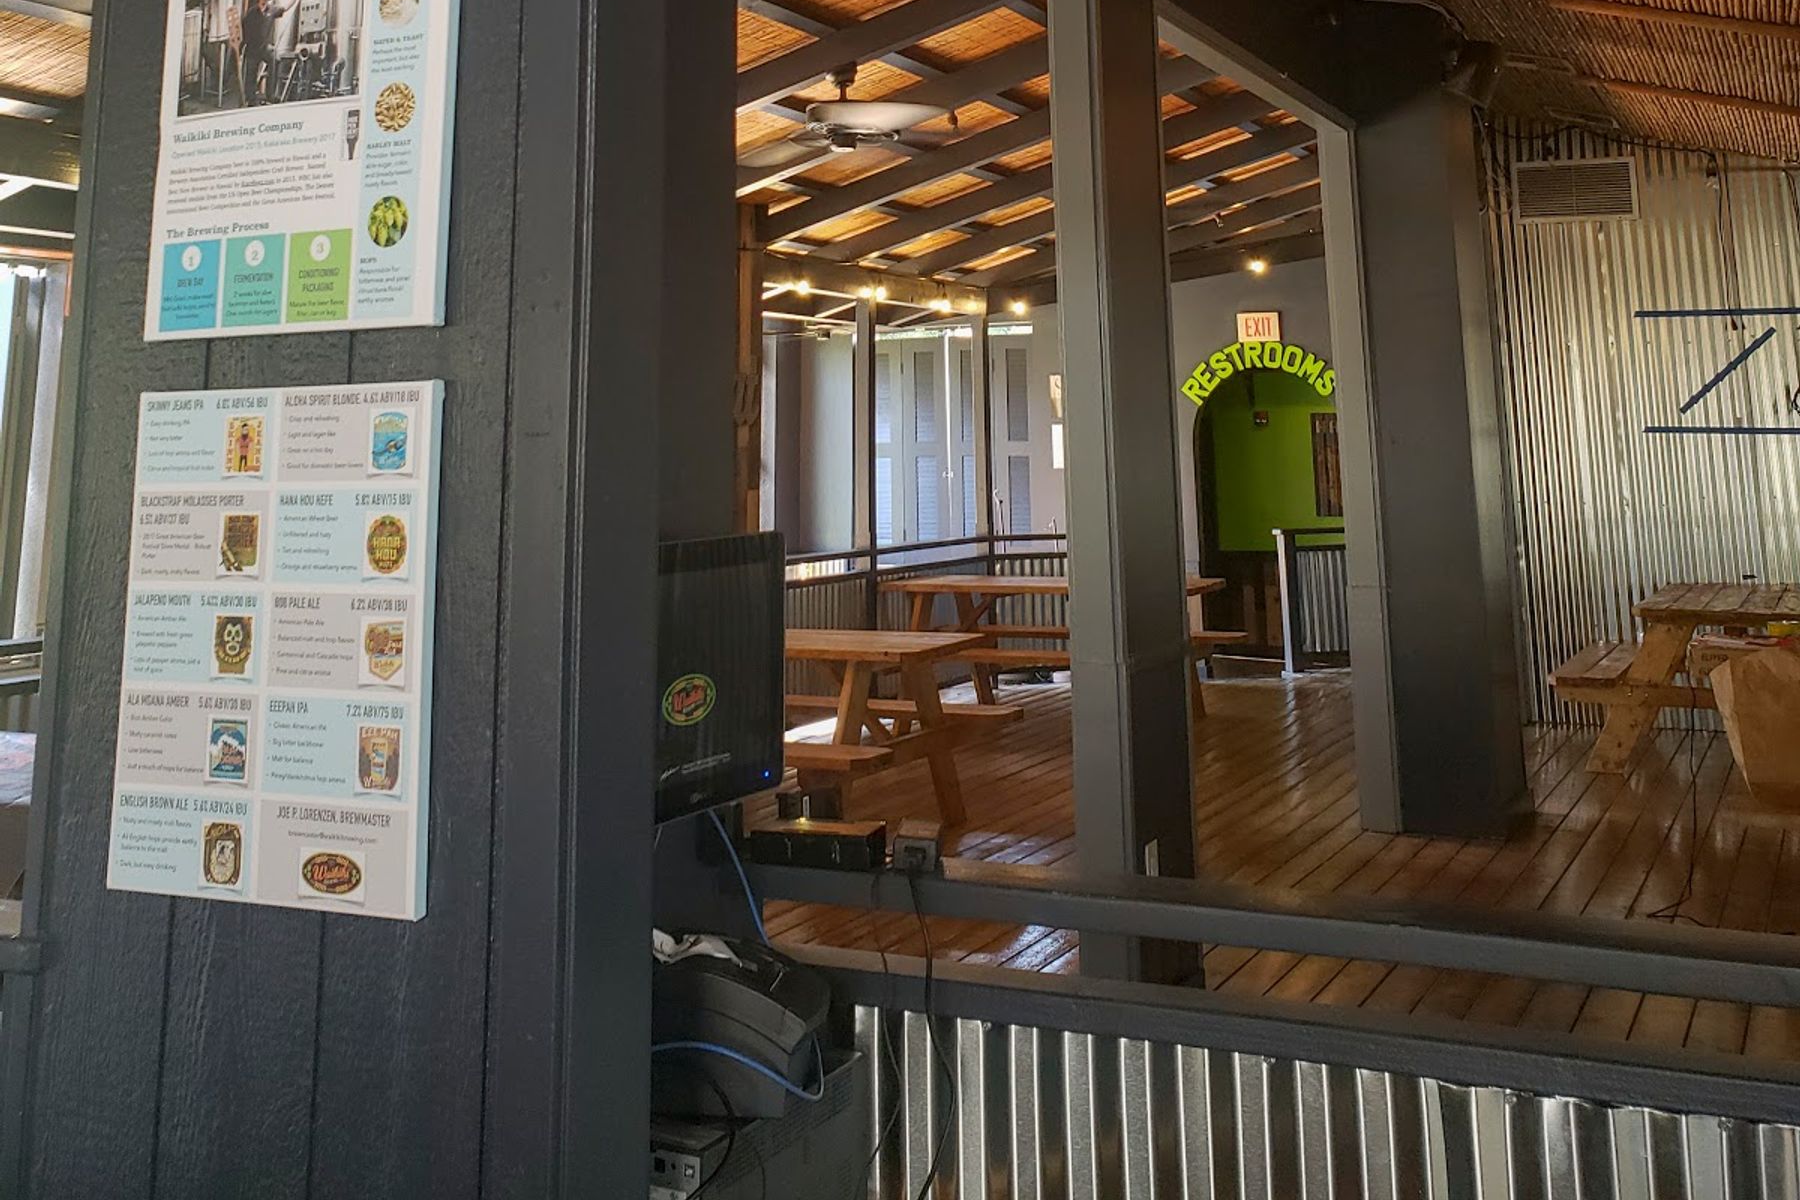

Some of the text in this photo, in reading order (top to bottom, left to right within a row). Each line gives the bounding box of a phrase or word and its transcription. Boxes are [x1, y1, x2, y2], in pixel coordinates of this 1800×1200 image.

[173, 121, 304, 144] Waikiki Brewing Company
[166, 222, 269, 238] The Brewing Process
[251, 250, 258, 261] 2
[1245, 316, 1273, 337] EXIT
[1181, 341, 1335, 406] RESTROOMS
[289, 597, 305, 608] PALE
[308, 597, 321, 609] ALE
[394, 599, 408, 612] IBU
[297, 701, 309, 713] IPA
[390, 706, 404, 720] IBU
[120, 795, 148, 808] ENGLISH
[176, 798, 188, 811] ALE
[276, 806, 290, 819] JOE
[339, 810, 391, 828] BREWMASTER
